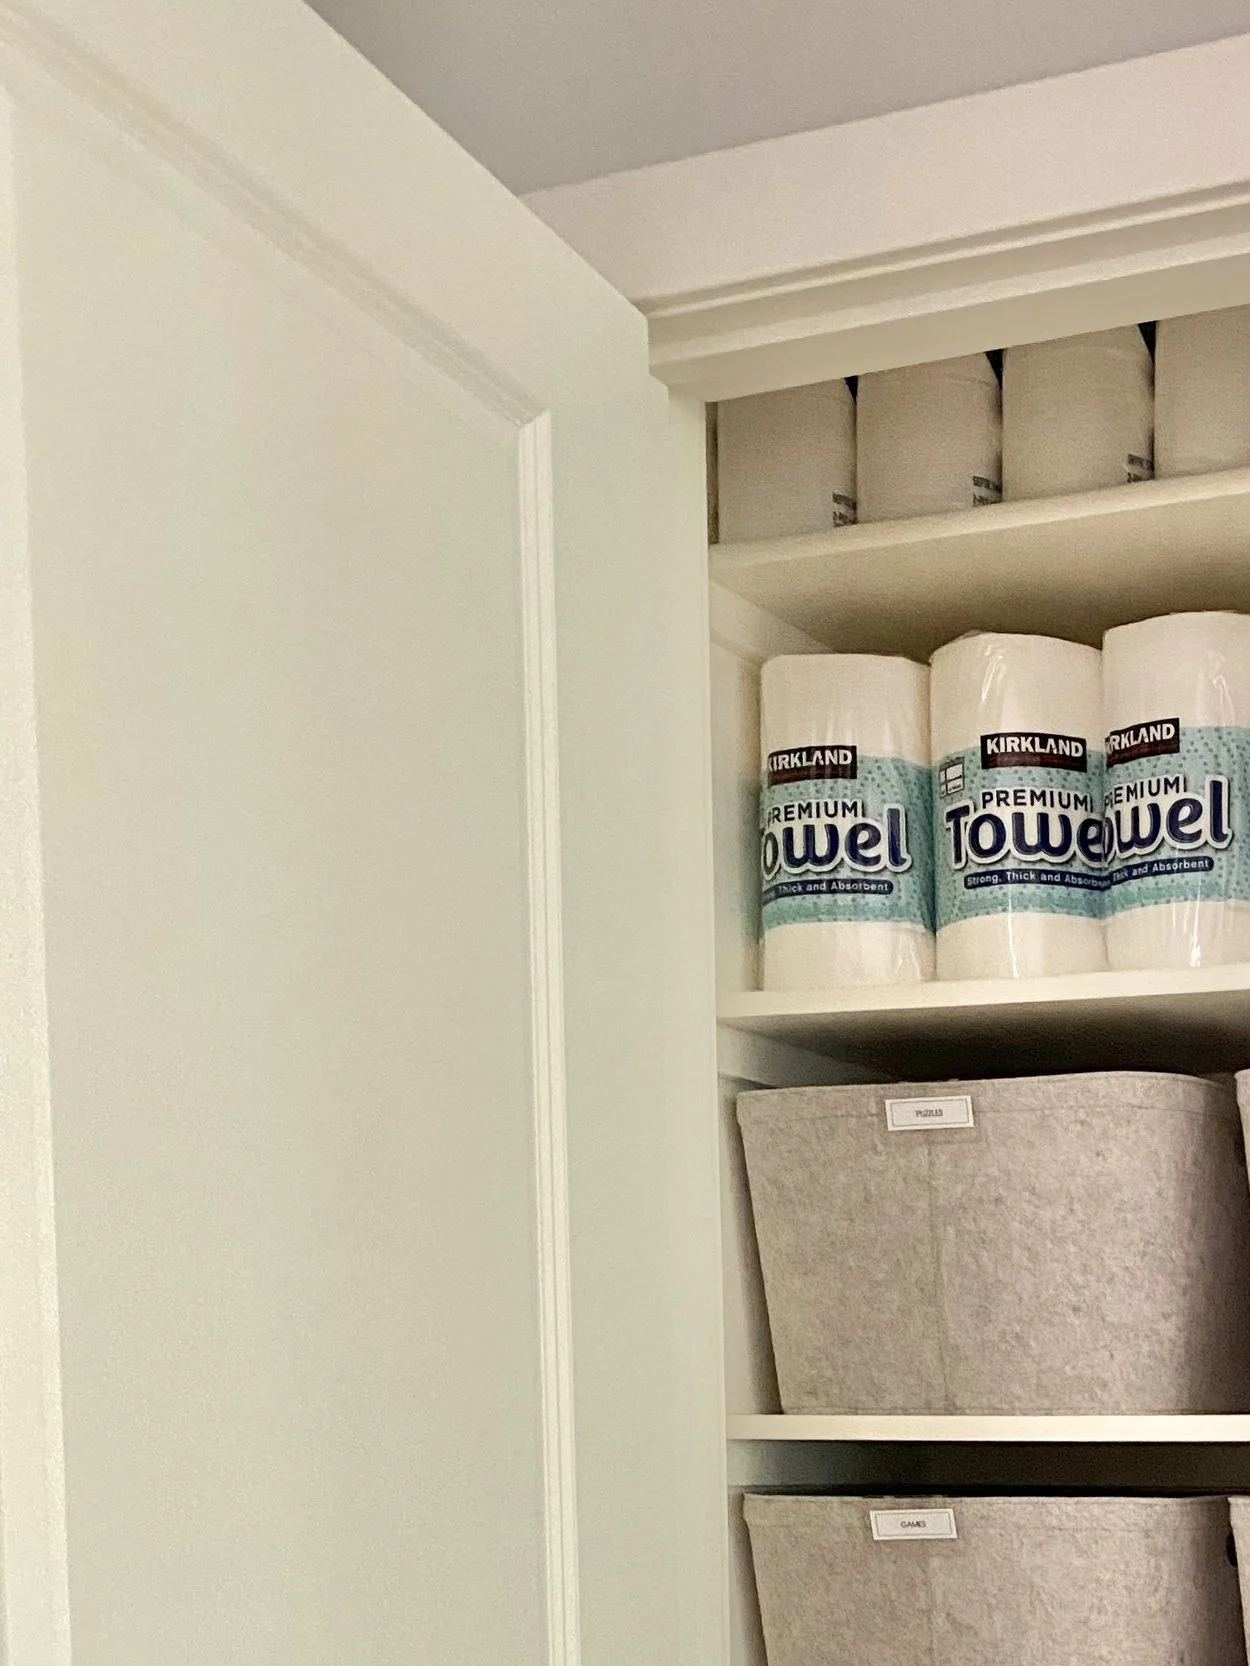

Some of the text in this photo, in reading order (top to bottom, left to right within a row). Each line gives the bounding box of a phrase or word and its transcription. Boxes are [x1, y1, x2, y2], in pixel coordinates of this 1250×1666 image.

[987, 736, 1083, 758] KIRKLAND
[768, 749, 853, 772] KIRKLAND
[982, 789, 1089, 811] PREMIUM
[1132, 864, 1148, 876] and
[1152, 859, 1209, 872] Absorbent
[1006, 871, 1036, 881] Thick
[1040, 872, 1061, 882] and
[779, 881, 890, 894] Thick and Absorbent
[915, 1109, 943, 1117] PUZZLES
[901, 1520, 927, 1529] GAMES
